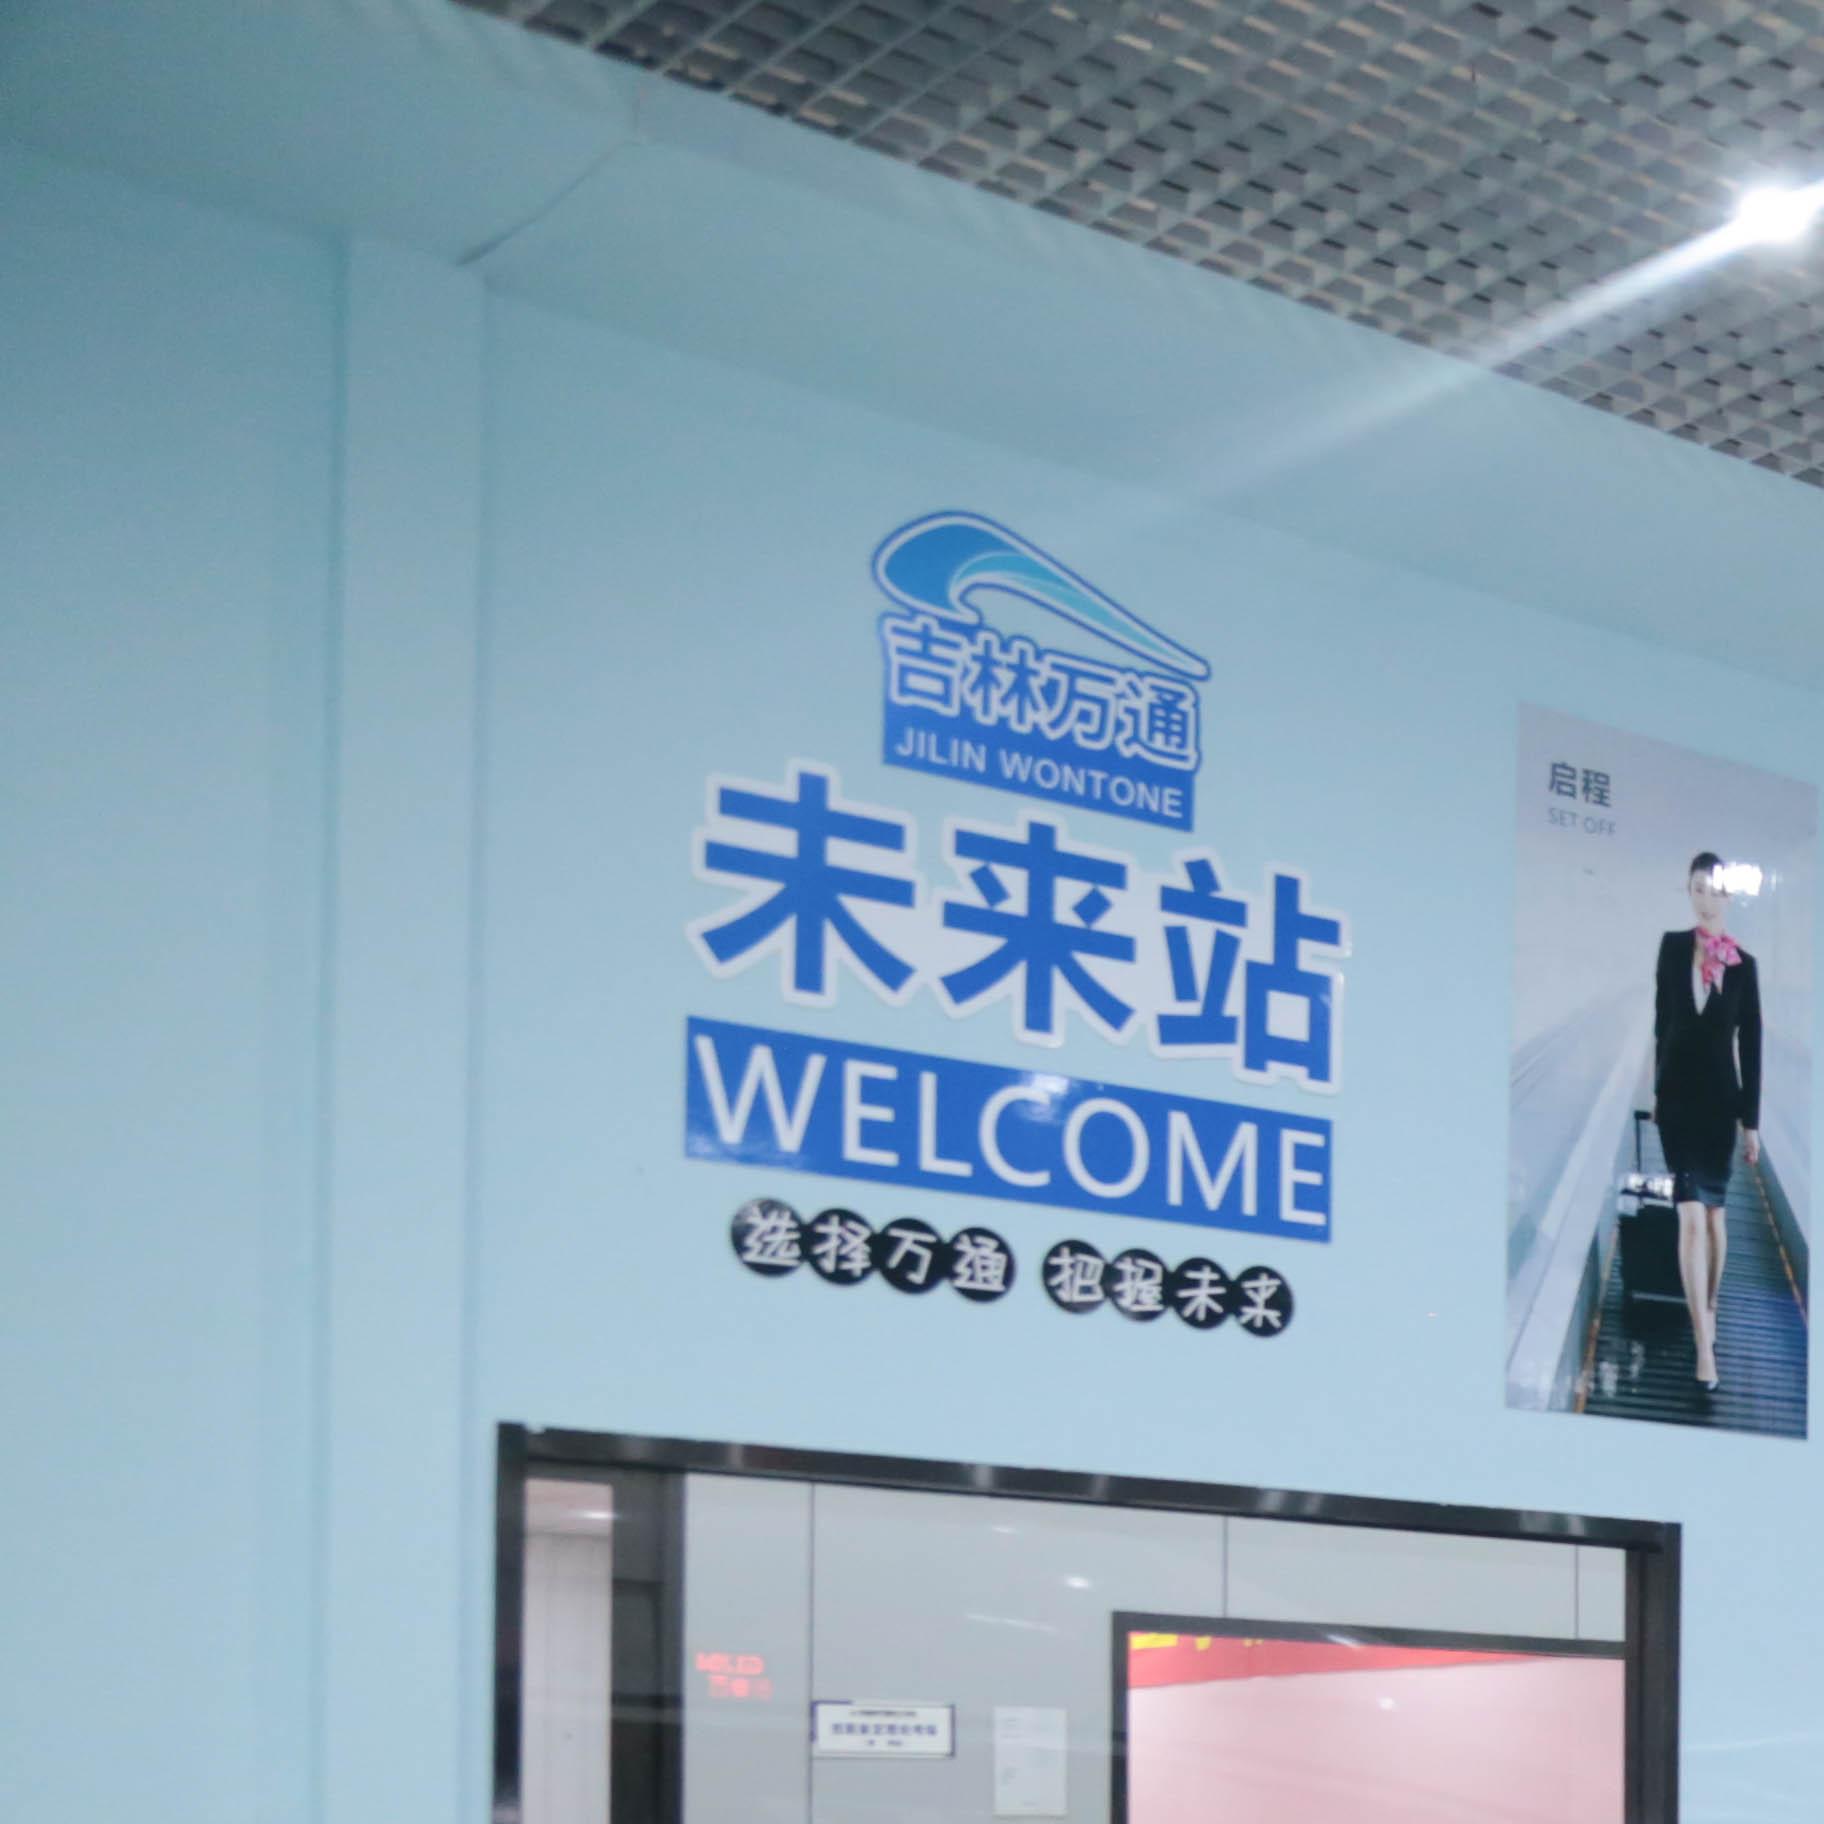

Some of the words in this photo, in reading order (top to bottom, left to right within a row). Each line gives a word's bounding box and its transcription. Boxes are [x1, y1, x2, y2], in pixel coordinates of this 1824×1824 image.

[884, 615, 1201, 769] 吉林万通
[895, 727, 988, 774] JILIN
[1001, 747, 1183, 819] WONTONE
[1549, 761, 1611, 807] 启程
[1549, 807, 1579, 832] SET
[1584, 814, 1616, 837] OFF
[702, 771, 1341, 1083] 未来站
[695, 1035, 1326, 1224] WELCOME
[740, 1209, 1012, 1295] 选择万通
[1049, 1250, 1287, 1330] 把握未来
